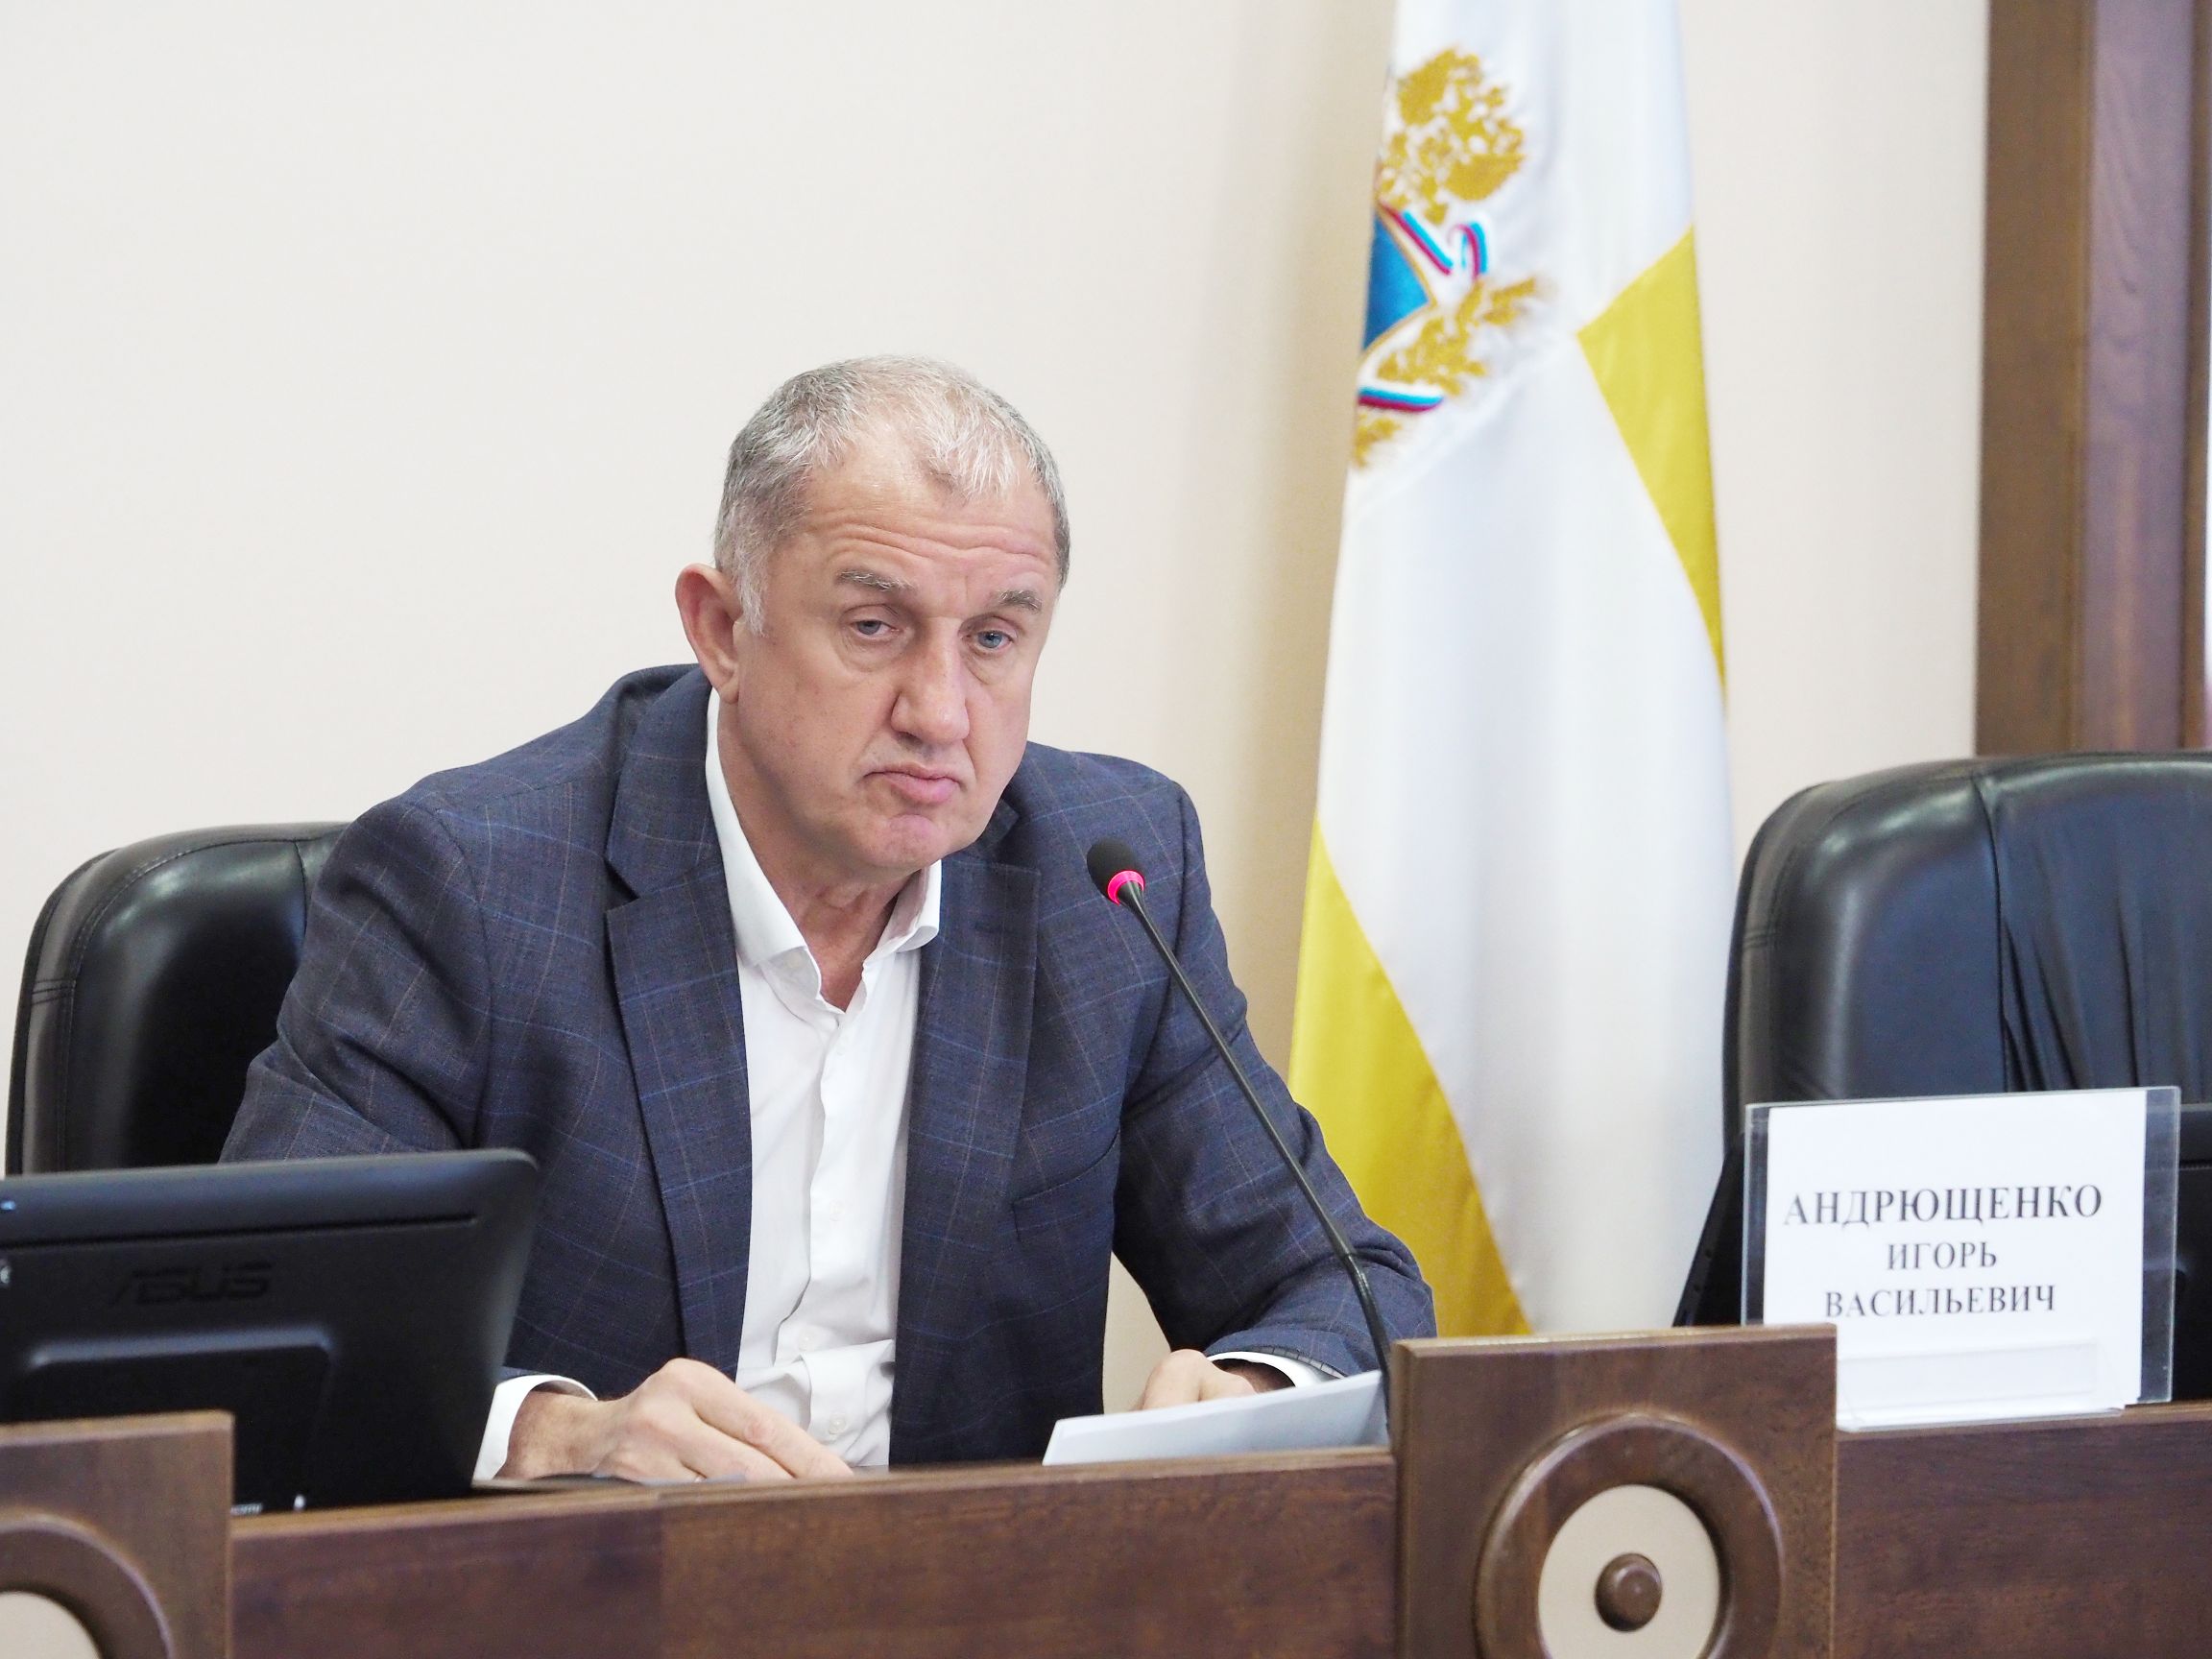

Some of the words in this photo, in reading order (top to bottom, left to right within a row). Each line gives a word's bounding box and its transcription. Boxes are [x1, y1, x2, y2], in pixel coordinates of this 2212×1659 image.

[1784, 1184, 2103, 1226] АНДРЮЩЕНКО
[1887, 1241, 1998, 1270] ИГОРЬ
[108, 1259, 276, 1308] ASUS
[1824, 1284, 2056, 1318] ВАСИЛЬЕВИЧ
